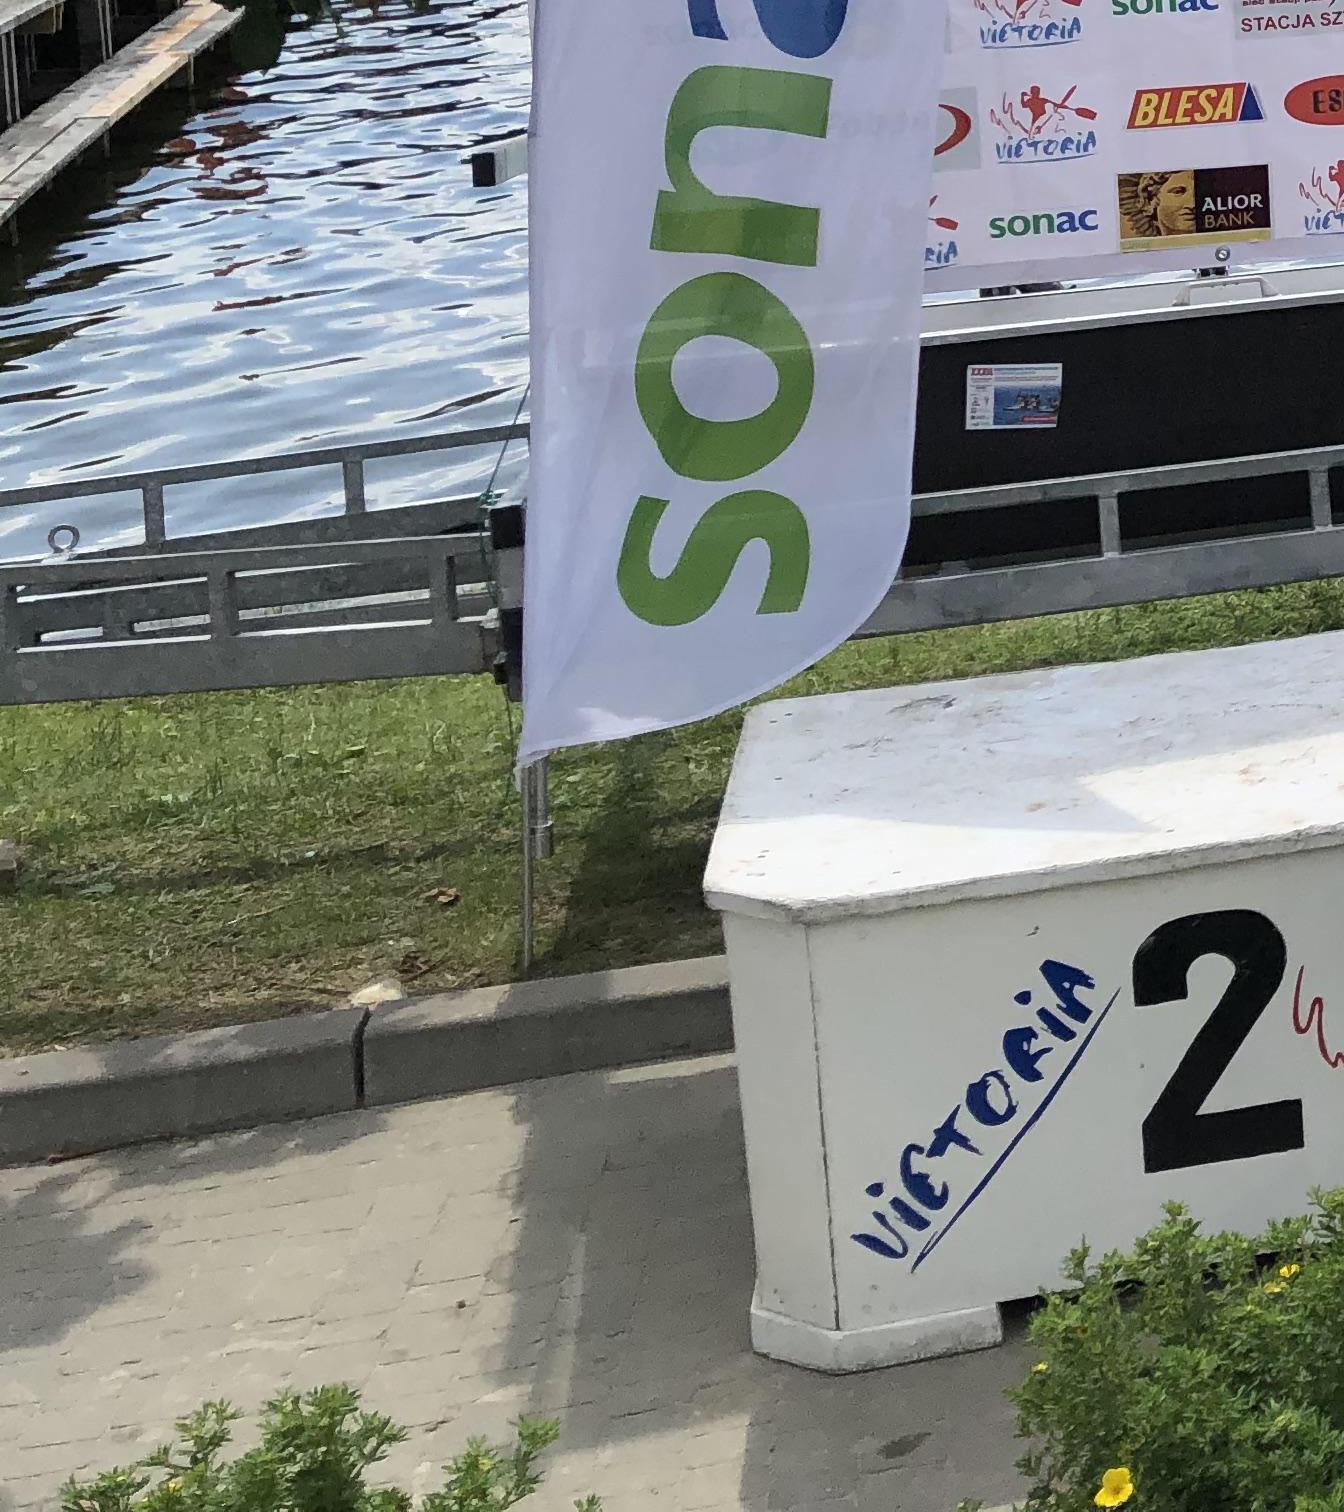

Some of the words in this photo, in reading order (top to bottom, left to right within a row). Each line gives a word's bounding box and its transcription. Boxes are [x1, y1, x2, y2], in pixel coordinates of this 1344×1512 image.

[1241, 11, 1316, 33] STACJA
[1135, 86, 1237, 126] BLESA
[1202, 194, 1264, 212] ALIOR
[989, 208, 1099, 238] sonac
[1205, 210, 1256, 229] BANK
[1132, 909, 1305, 1174] 2
